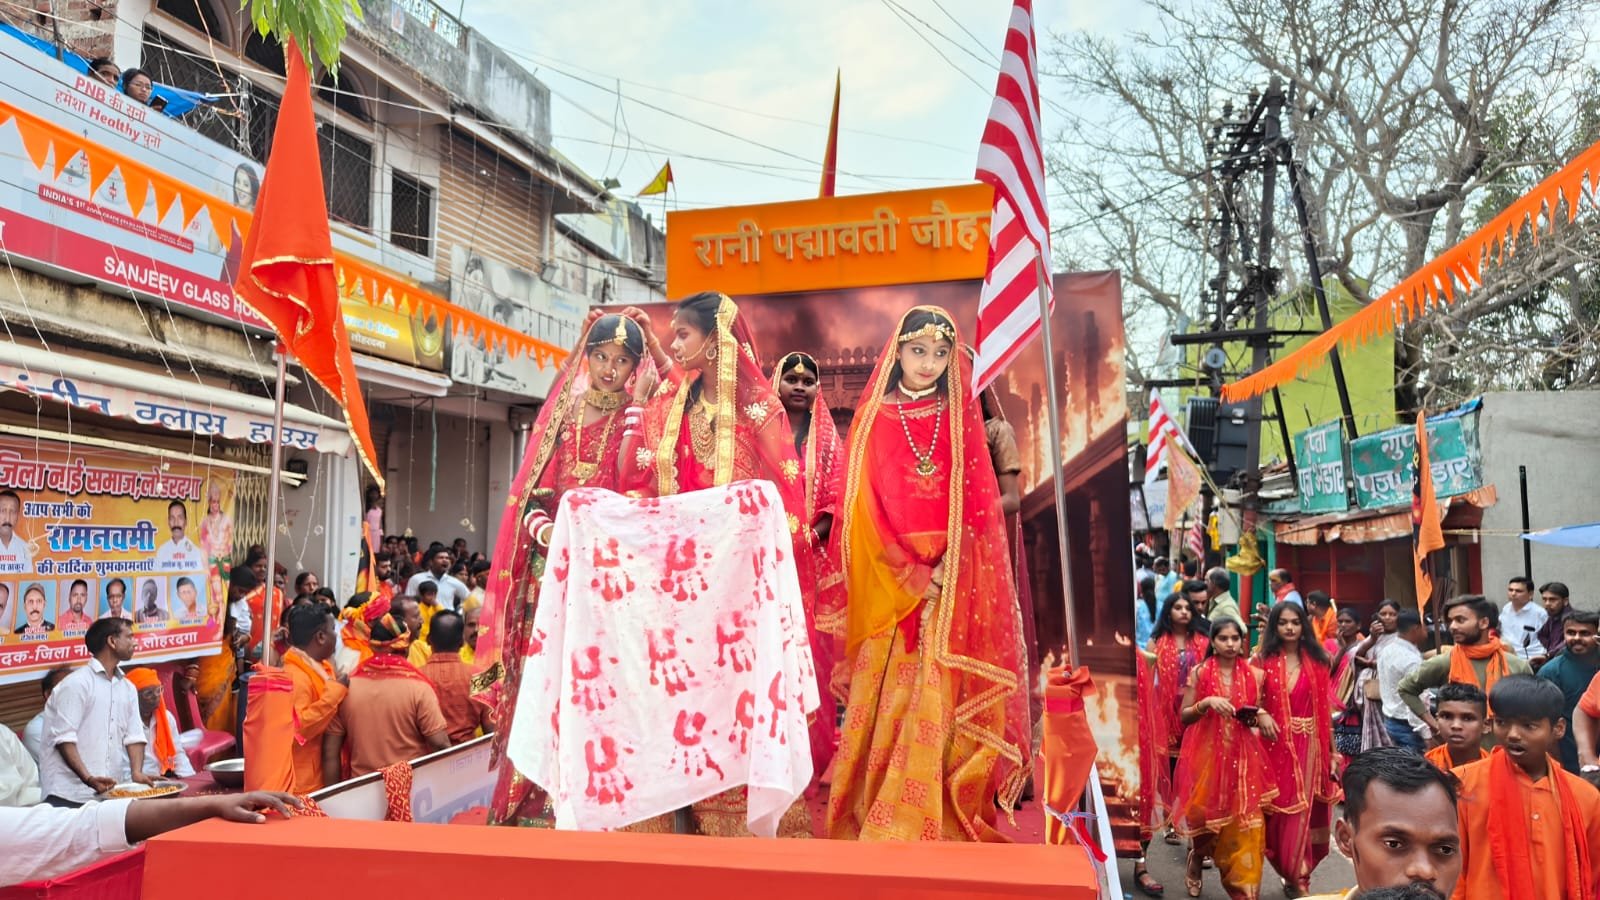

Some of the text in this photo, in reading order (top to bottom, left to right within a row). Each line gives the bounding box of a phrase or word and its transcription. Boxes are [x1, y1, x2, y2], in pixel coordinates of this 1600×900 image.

[55, 89, 86, 113] हमेशा
[89, 106, 141, 141] Healthy
[75, 76, 147, 123] PNB की सुनो
[42, 187, 74, 206] INDIA'S
[692, 219, 763, 267] रानी
[770, 205, 900, 260] पद्मावती
[104, 256, 180, 293] SANJEEV
[182, 281, 230, 310] GLASS
[135, 401, 319, 446] ग्लास हाउस
[24, 502, 92, 519] आप सभी को
[46, 519, 157, 552] रामनवमी
[36, 559, 54, 575] की
[56, 559, 92, 575] हार्दिक
[73, 644, 88, 657] ना
